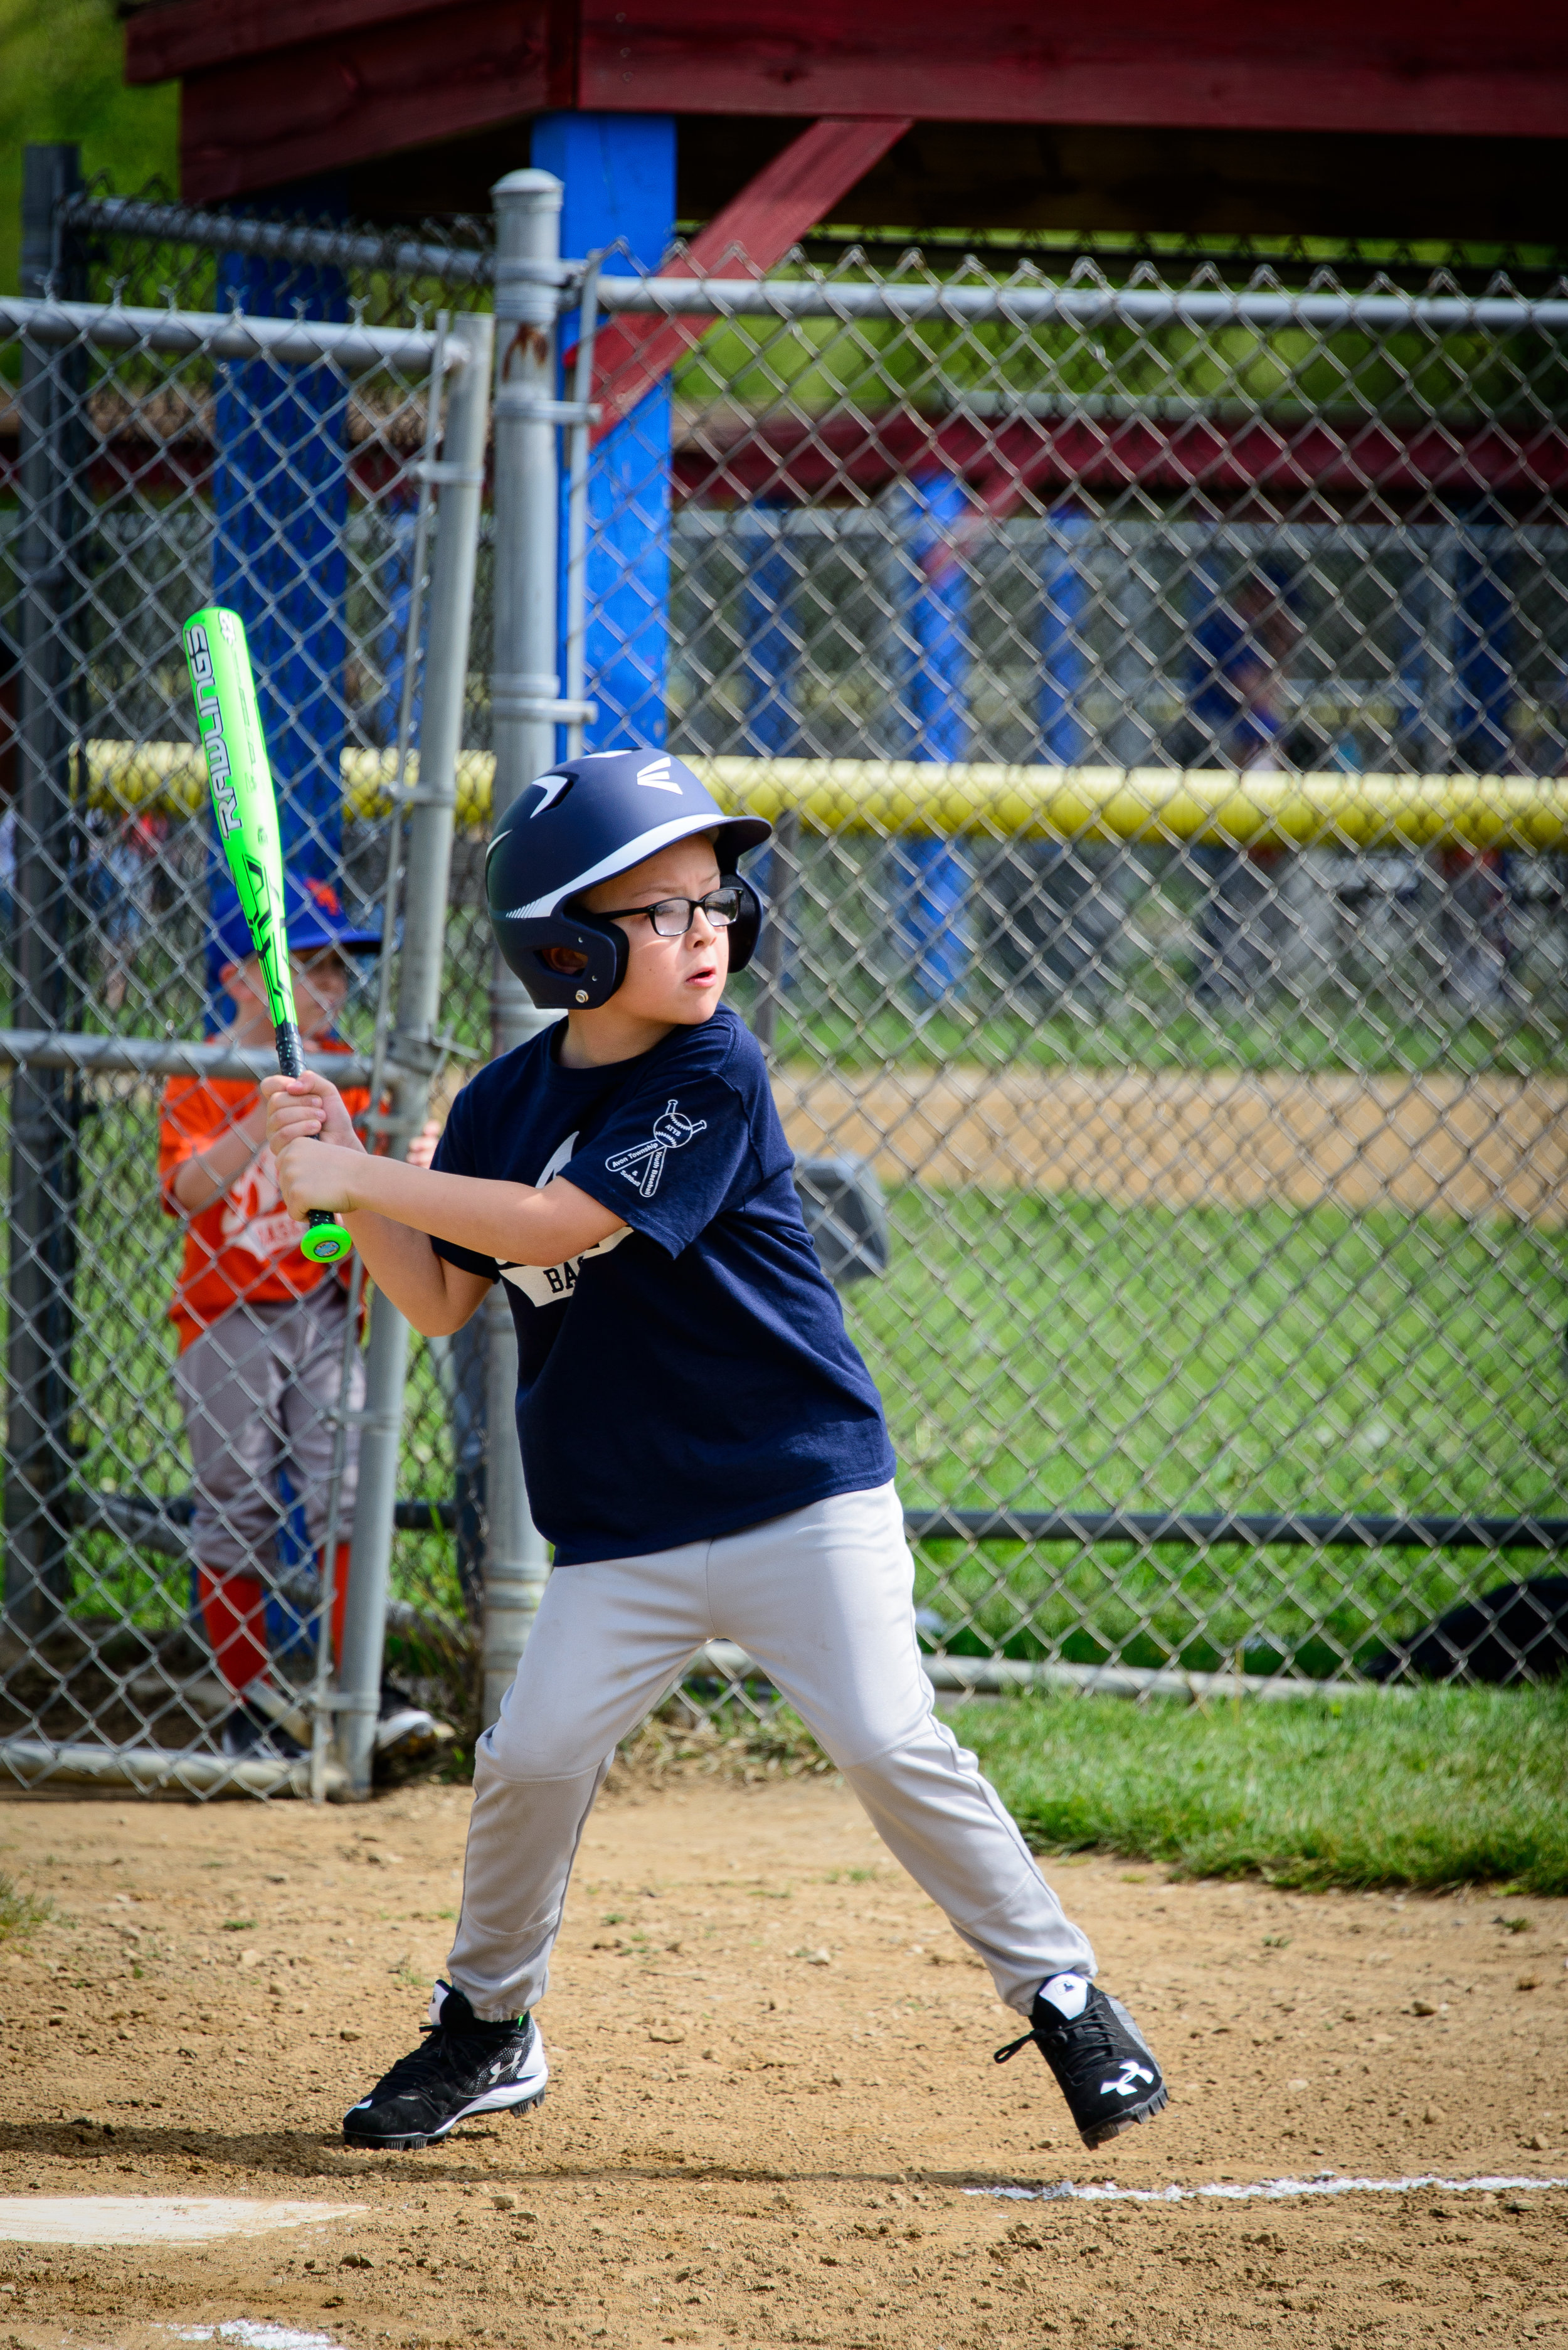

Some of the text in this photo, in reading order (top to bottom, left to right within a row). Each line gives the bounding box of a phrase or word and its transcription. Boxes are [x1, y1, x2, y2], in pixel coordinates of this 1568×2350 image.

[184, 623, 243, 840] RAWLINGS
[665, 1124, 682, 1137] ATYB
[612, 1142, 659, 1168] Avon Township
[620, 1170, 641, 1187] Softball
[644, 1151, 663, 1195] Youth Baseball
